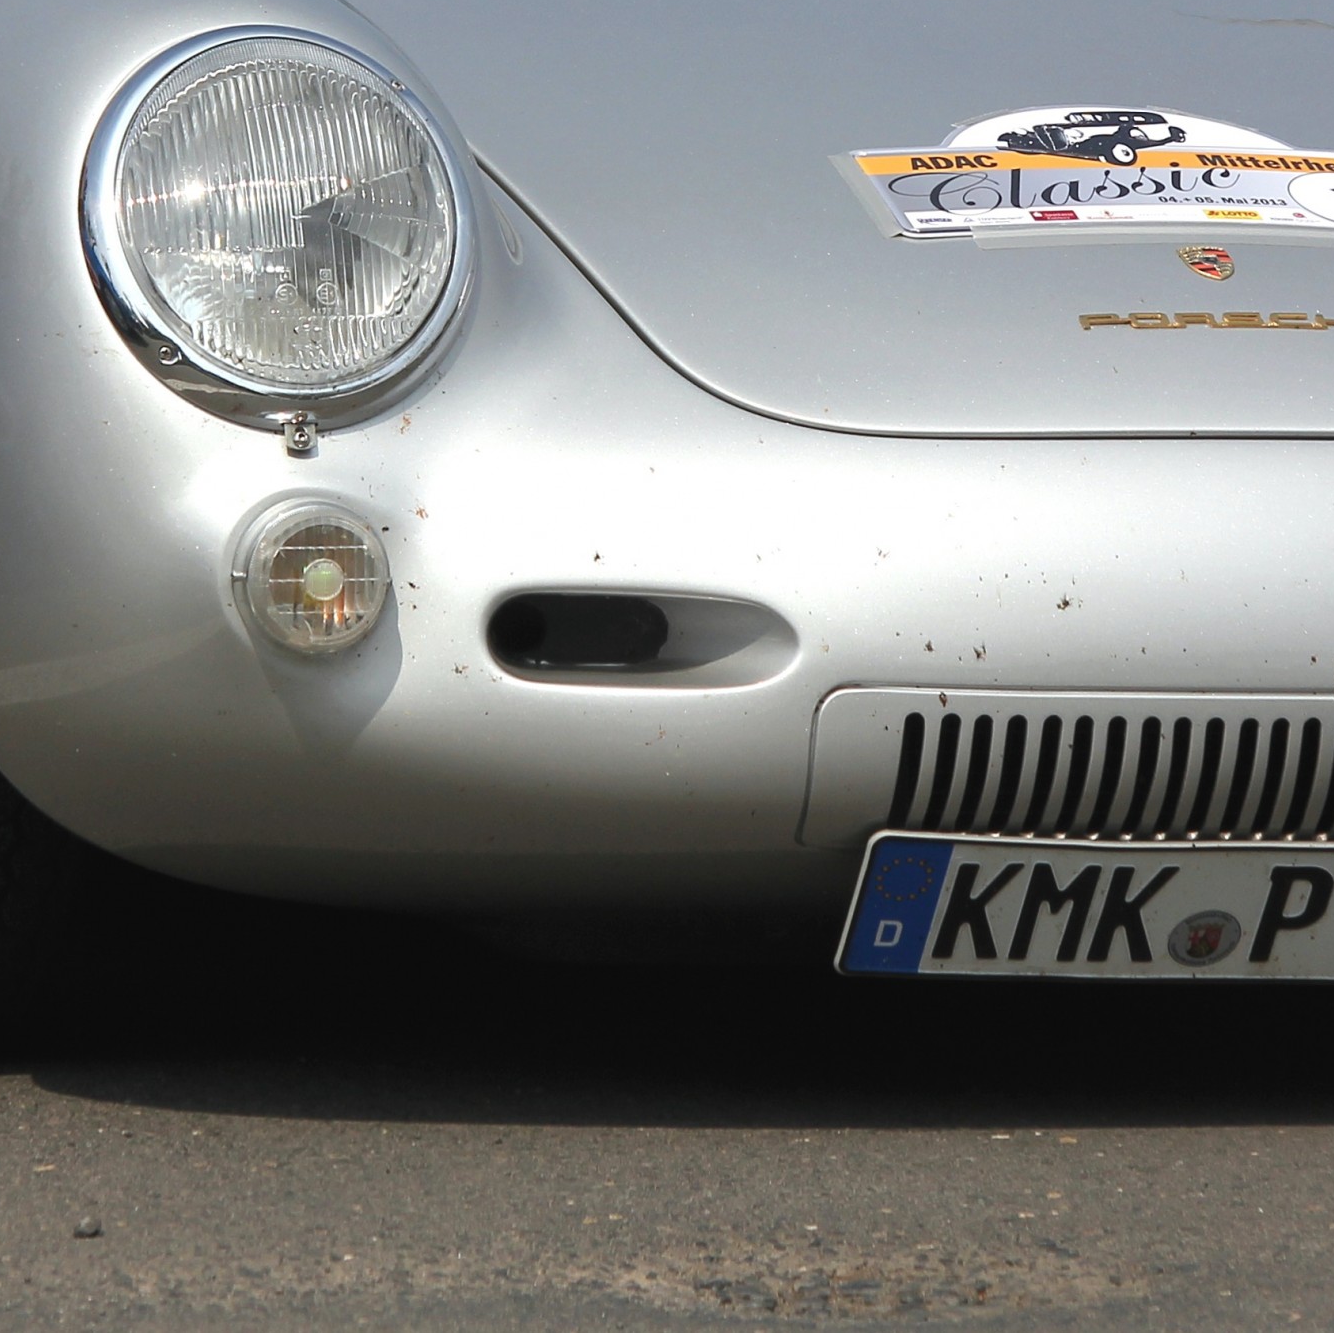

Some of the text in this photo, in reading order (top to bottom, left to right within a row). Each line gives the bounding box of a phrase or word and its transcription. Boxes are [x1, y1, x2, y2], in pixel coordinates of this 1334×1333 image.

[911, 154, 998, 171] ADAC
[888, 160, 1241, 217] Classic
[1221, 196, 1248, 205] Mai
[1250, 197, 1288, 207] 2013
[1221, 210, 1259, 218] LOTTO
[931, 861, 1181, 963] KMK
[1247, 864, 1334, 963] P
[873, 919, 904, 948] D
